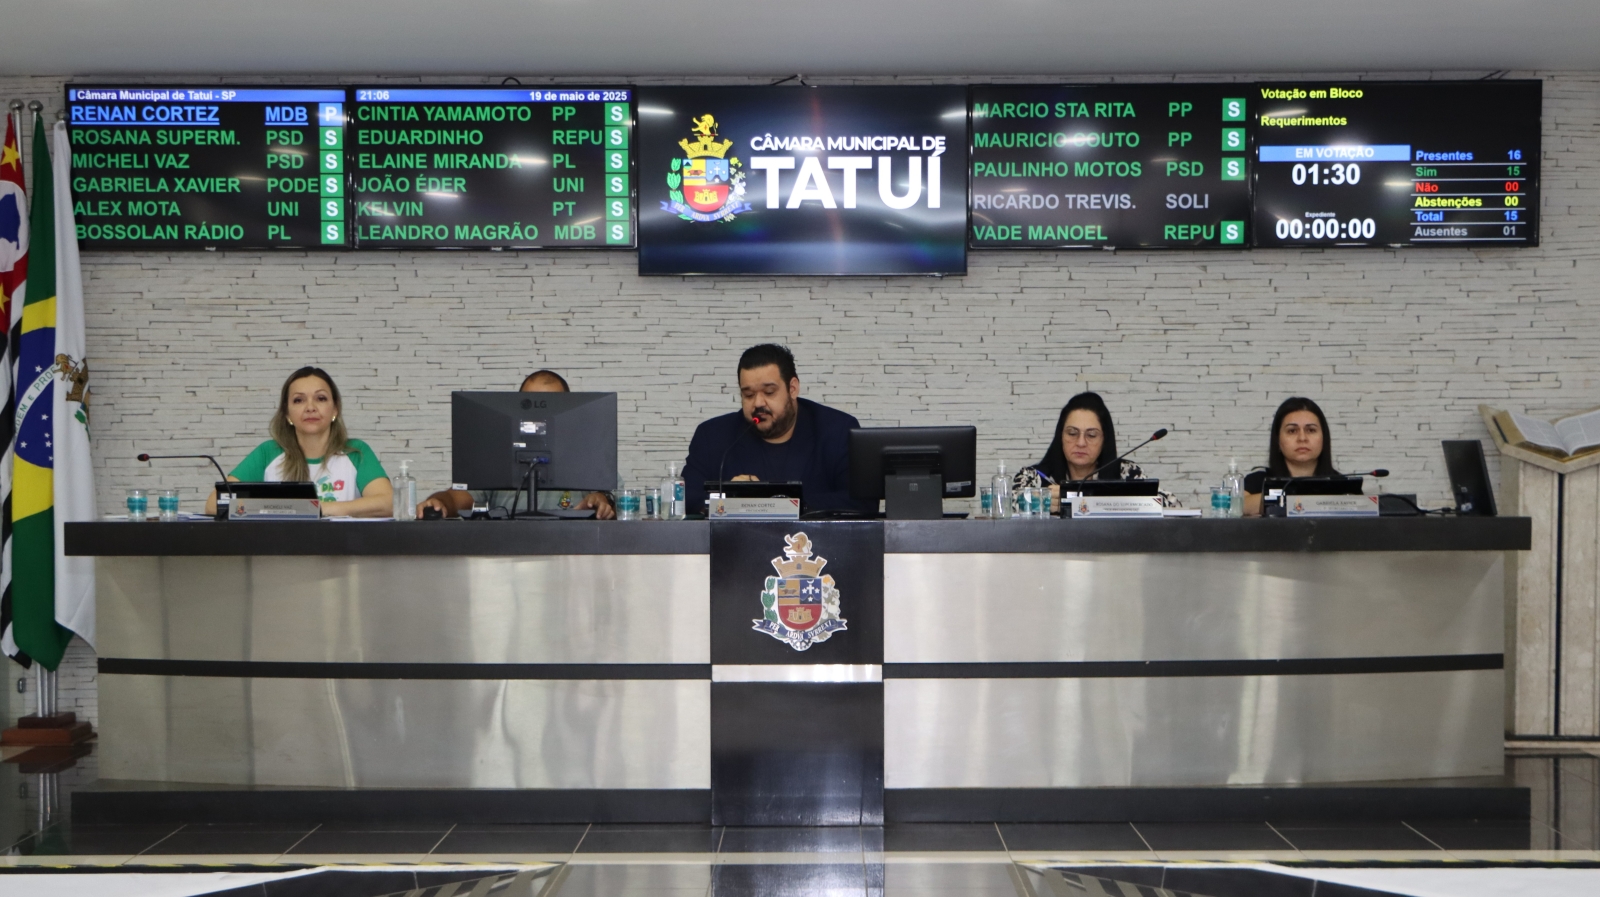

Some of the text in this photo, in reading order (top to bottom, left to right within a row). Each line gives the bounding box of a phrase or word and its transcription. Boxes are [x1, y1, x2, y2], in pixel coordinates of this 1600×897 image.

[77, 90, 117, 100] Câmara
[119, 91, 169, 101] Municipal
[173, 91, 184, 100] de
[222, 92, 236, 100] SP
[360, 92, 389, 100] 21:06
[530, 92, 627, 101] 19 de maio de 2025
[1261, 89, 1363, 100] Votação em Bloco
[71, 106, 219, 121] RENAN CORTEZ
[265, 107, 307, 121] MDB
[325, 107, 337, 120] P
[358, 106, 531, 121] CINTIA YAMAMOTO
[553, 107, 576, 121] PP
[611, 107, 622, 121] S
[975, 103, 1135, 118] MARCIO STA RITA
[1169, 103, 1192, 117] PP
[1228, 102, 1240, 117] S
[1261, 116, 1347, 128] Requerimentos
[72, 130, 241, 145] ROSANA SUPERM.
[266, 131, 303, 145] PSD
[325, 131, 337, 145] S
[359, 130, 483, 145] EDUARDINHO
[553, 130, 602, 145] REPU
[611, 130, 622, 145] S
[751, 133, 945, 151] CÂMARA MUNICIPAL DE
[975, 133, 1140, 148] MAURICIO COUTO
[1168, 133, 1192, 147] PP
[1228, 132, 1240, 147] S
[1296, 147, 1374, 159] EM VOTAÇÃO
[1416, 151, 1473, 162] Presentes
[1508, 150, 1521, 160] 16
[73, 154, 189, 168] MICHELI VAZ
[267, 154, 304, 169] PSD
[326, 154, 337, 169] S
[359, 154, 522, 168] ELAINE MIRANDA
[553, 154, 575, 168] PL
[611, 154, 622, 168] S
[975, 162, 1142, 177] PAULINHO MOTOS
[1166, 162, 1204, 177] PSD
[1227, 161, 1239, 176] S
[1292, 163, 1360, 185] 01:30
[1416, 167, 1437, 177] Sim
[1507, 167, 1520, 176] 15
[73, 178, 240, 192] GABRIELA XAVIER
[358, 174, 466, 192] JOÃO ÉDER
[553, 178, 584, 192] UNI
[611, 177, 623, 192] S
[751, 147, 946, 209] TATUÍ
[268, 178, 318, 193] PODE
[326, 178, 338, 193] S
[1415, 182, 1438, 192] Não
[1505, 182, 1519, 192] 00
[74, 201, 181, 216] ALEX MOTA
[553, 201, 576, 216] PT
[611, 201, 623, 216] S
[974, 194, 1136, 209] RICARDO TREVIS.
[1166, 194, 1208, 209] SOLI
[1415, 197, 1482, 208] Abstenções
[1505, 197, 1518, 207] 00
[268, 202, 298, 216] UNI
[326, 202, 338, 216] S
[358, 202, 423, 216] KELVIN
[1504, 211, 1518, 221] 15
[1415, 212, 1443, 221] Total
[76, 222, 244, 239] BOSSOLAN RÁDIO
[268, 225, 291, 239] PL
[327, 225, 339, 239] S
[359, 222, 538, 240] LEANDRO MAGRÃO
[555, 225, 596, 239] MDB
[612, 225, 623, 240] S
[973, 226, 1107, 240] VADE MANOEL
[1165, 225, 1215, 240] REPU
[1226, 225, 1238, 240] S
[1276, 218, 1375, 239] 00:00:00
[1414, 226, 1467, 236] Ausentes
[1503, 226, 1516, 236] 01
[769, 622, 780, 631] PER
